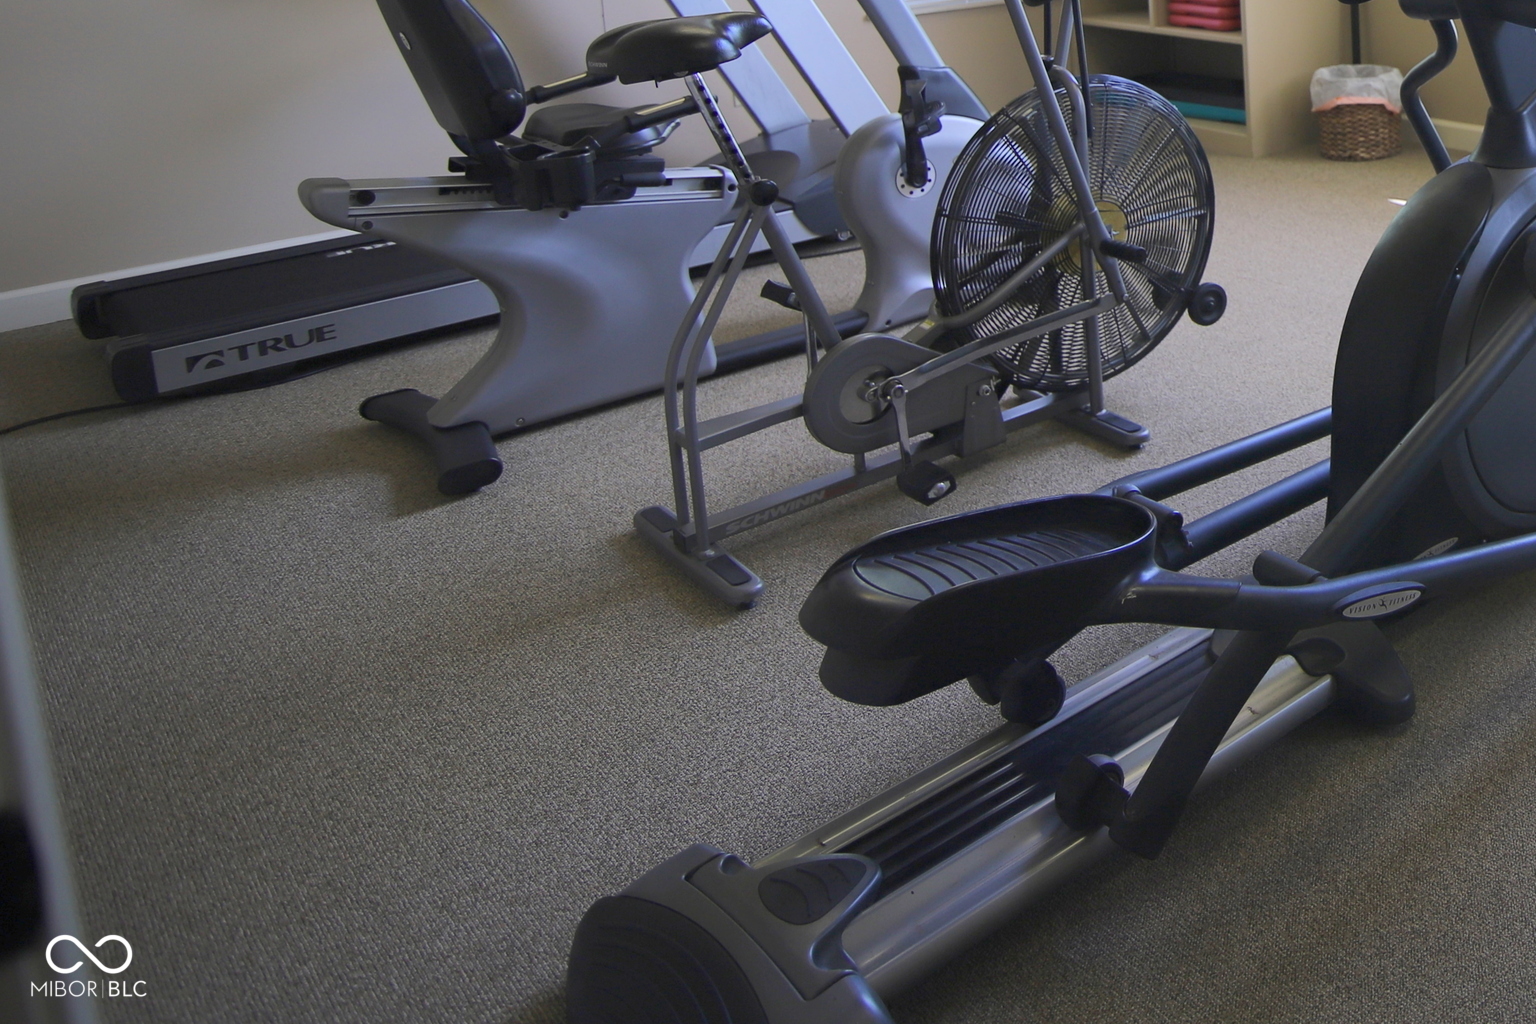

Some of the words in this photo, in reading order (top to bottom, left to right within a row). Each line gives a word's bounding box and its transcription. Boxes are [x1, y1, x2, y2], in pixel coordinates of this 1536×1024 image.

[228, 323, 338, 362] TRUE
[725, 490, 826, 536] SCHWINN
[1349, 602, 1378, 615] VISION
[1388, 592, 1417, 607] FITNESS
